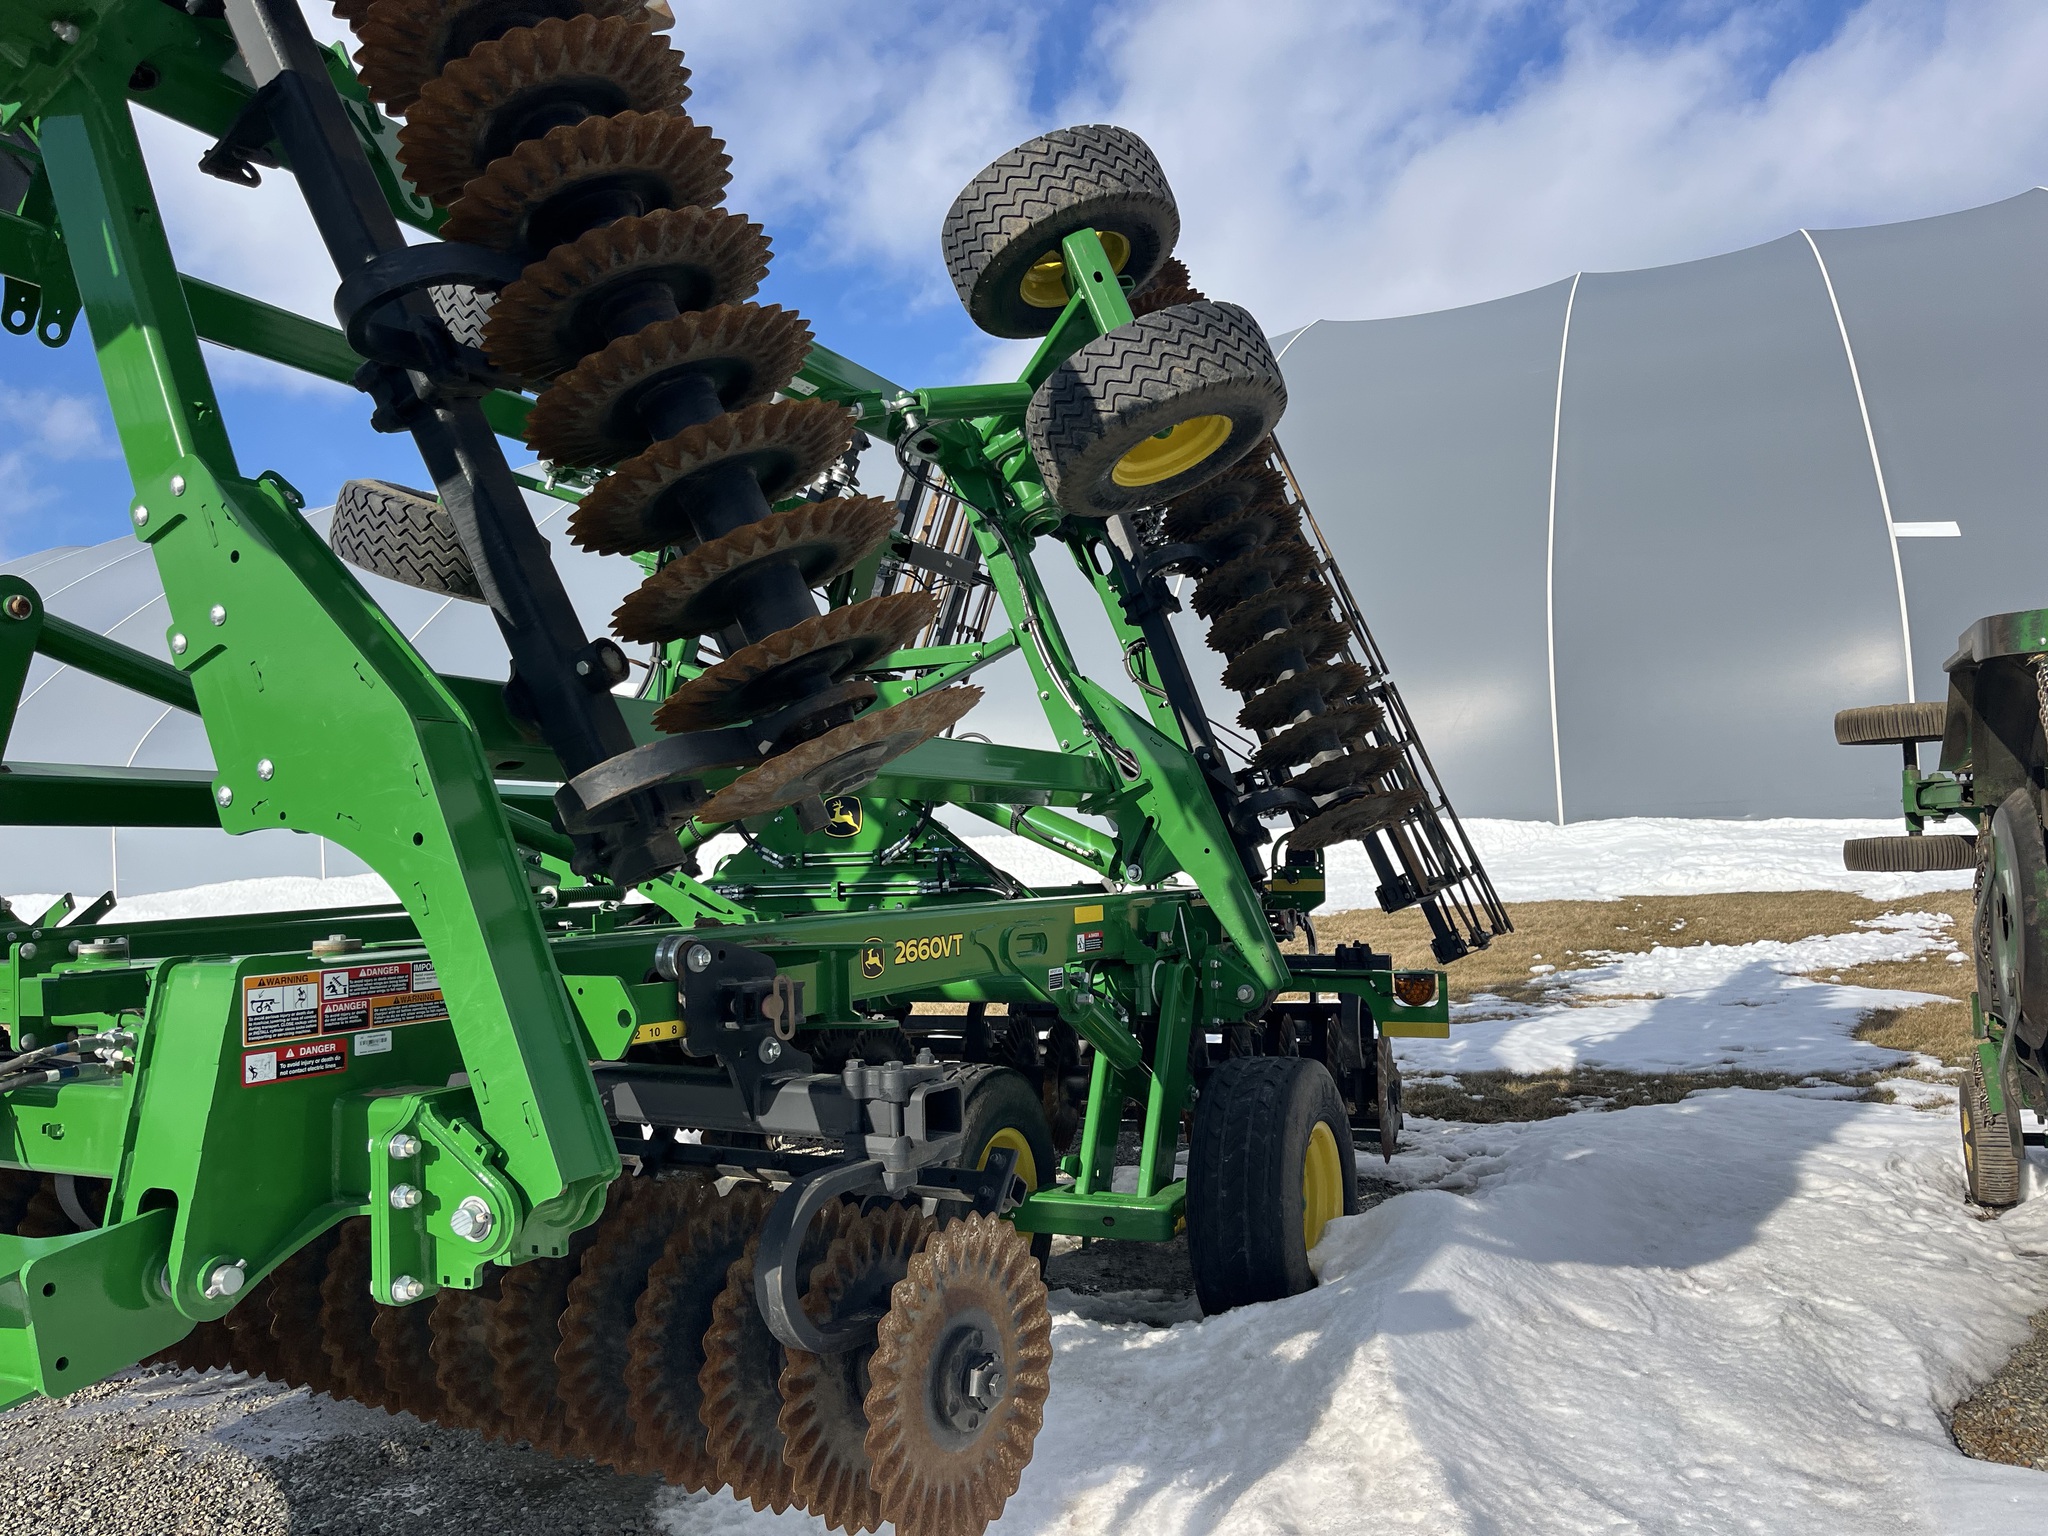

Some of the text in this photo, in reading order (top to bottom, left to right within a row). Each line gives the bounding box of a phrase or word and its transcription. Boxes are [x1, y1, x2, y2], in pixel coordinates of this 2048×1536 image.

[894, 934, 964, 964] 2660VT
[367, 966, 399, 976] DANGER
[266, 974, 308, 986] WARNING
[400, 993, 434, 1003] WARNING
[333, 1001, 367, 1012] DANGER
[649, 1027, 660, 1037] 10
[672, 1025, 677, 1034] 8
[300, 1044, 336, 1056] DANGER
